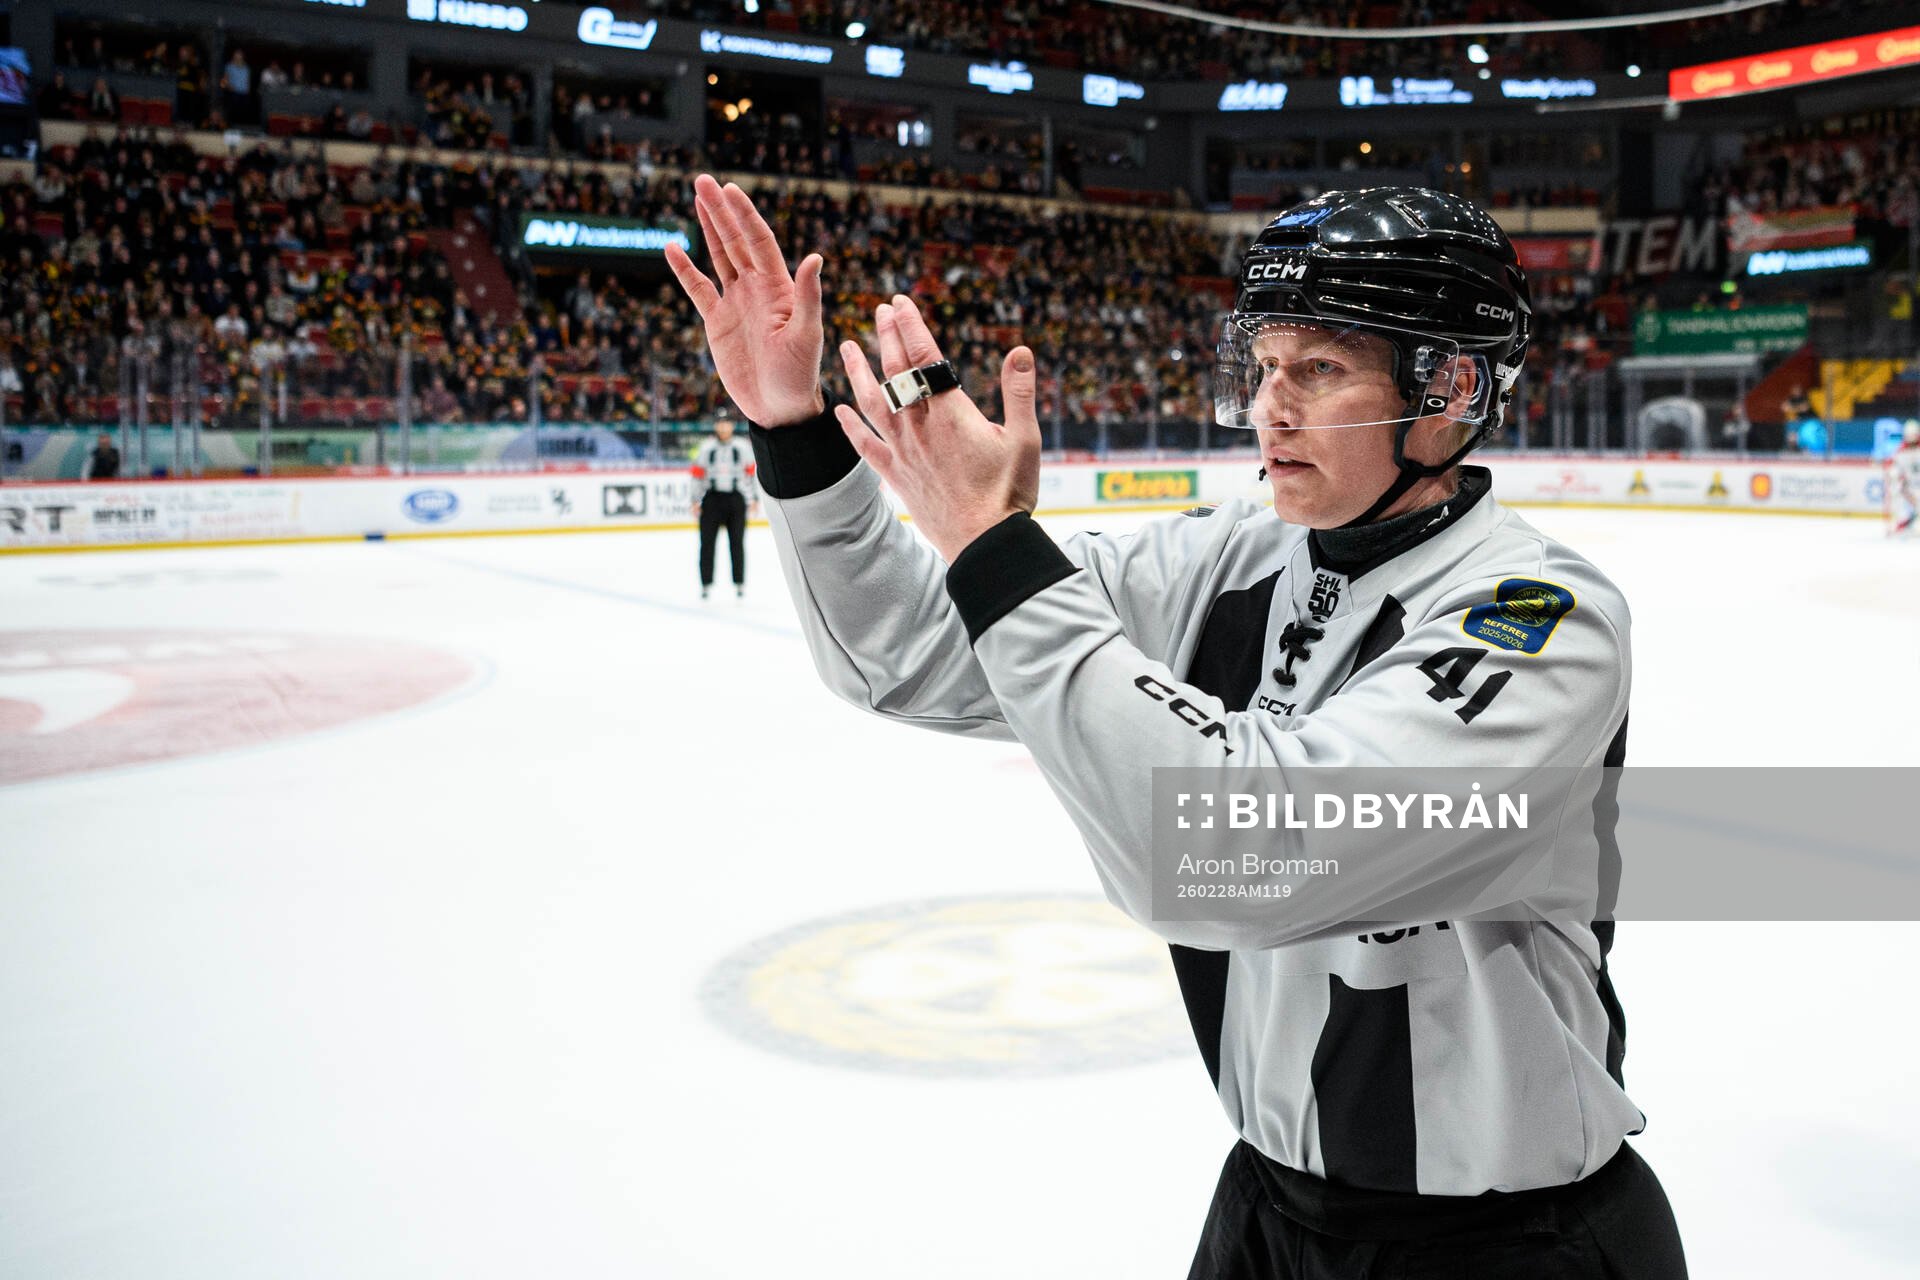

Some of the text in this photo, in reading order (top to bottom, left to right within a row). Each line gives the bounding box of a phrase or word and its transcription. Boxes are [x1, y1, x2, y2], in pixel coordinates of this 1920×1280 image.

[1247, 263, 1308, 280] CCM
[1475, 302, 1515, 322] CCM
[1314, 573, 1342, 593] SHL
[1308, 586, 1340, 623] 50
[1478, 626, 1524, 649] 2025/2026
[1483, 617, 1529, 641] REFEREE
[1415, 647, 1514, 725] 41
